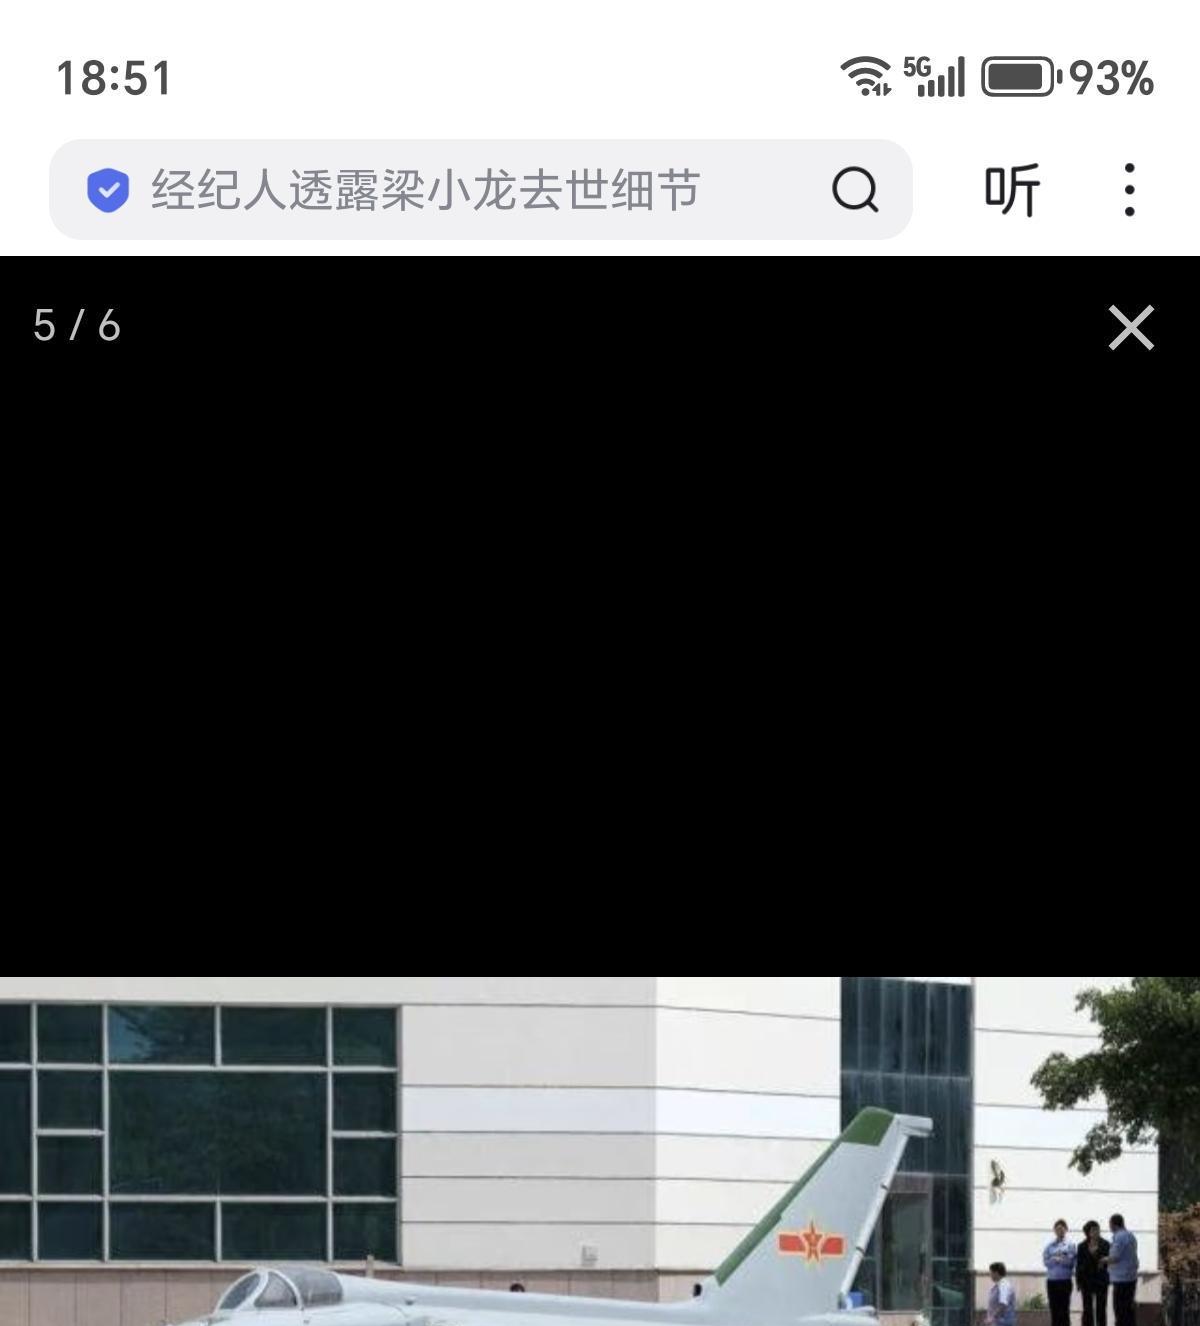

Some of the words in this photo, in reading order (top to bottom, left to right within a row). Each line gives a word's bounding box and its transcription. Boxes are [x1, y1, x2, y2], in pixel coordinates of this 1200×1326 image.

[57, 59, 168, 96] 18:51
[903, 55, 932, 78] 5G
[1069, 59, 1155, 96] 93%
[151, 167, 701, 212] 经纪人透露梁小龙去世细节
[984, 162, 1042, 219] 听
